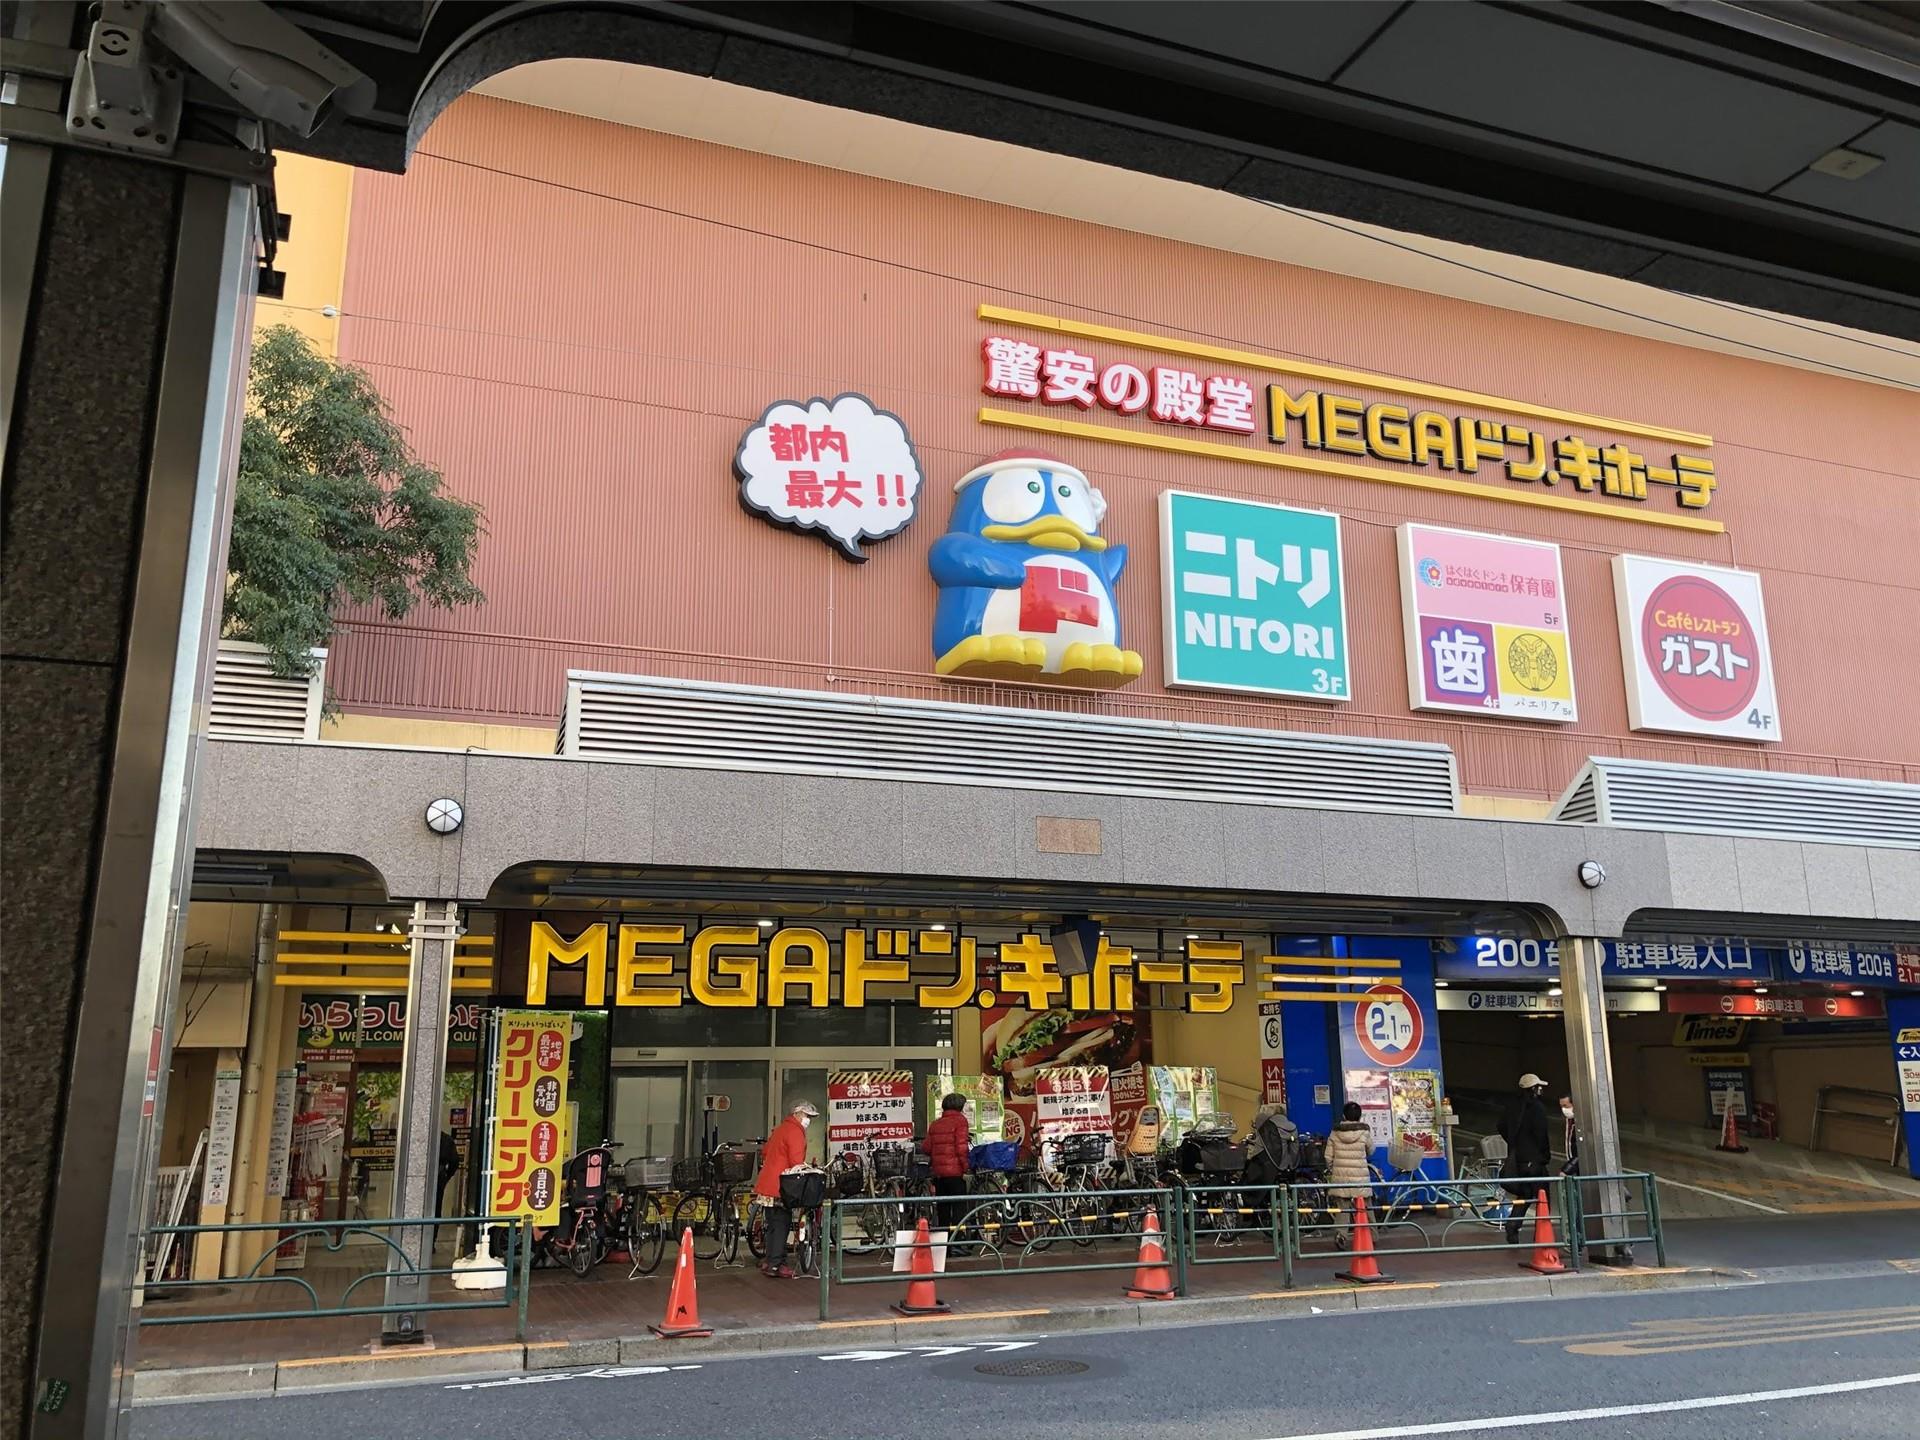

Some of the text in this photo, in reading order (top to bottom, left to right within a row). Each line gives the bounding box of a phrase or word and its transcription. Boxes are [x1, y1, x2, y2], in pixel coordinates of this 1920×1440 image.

[984, 336, 1255, 434] 驚安の殿堂
[769, 424, 850, 463] 都内
[1183, 531, 1331, 608] ニトリ
[1510, 573, 1556, 598] 保育園
[1544, 612, 1559, 625] 5F
[1184, 611, 1336, 661] NITORI
[1430, 629, 1487, 695] 歯
[1661, 635, 1749, 681] ガスト
[1312, 669, 1343, 696] 3F
[1483, 695, 1500, 709] 4F
[1747, 707, 1772, 730] 4F
[1615, 941, 1753, 971] 駐車場入口
[1810, 949, 1853, 976] 駐車場
[1856, 952, 1893, 977] 200台
[1484, 995, 1537, 1008] 駐車場入口
[1545, 996, 1563, 1008] 高さ
[1754, 999, 1804, 1012] 対向車注意
[339, 1030, 477, 1043] WELCOM QUI
[1371, 1006, 1412, 1041] 2.1m
[1683, 1019, 1739, 1041] Times
[538, 1034, 562, 1067] 地域 最安値
[535, 1081, 558, 1111] 非対面 受付
[847, 1084, 893, 1097] お知らせ
[1110, 1076, 1145, 1092] 直火焼き
[836, 1100, 906, 1110] 新規テナント工事が
[496, 1028, 535, 1212] クリーニング
[539, 1123, 550, 1162] 工場直営
[534, 1169, 548, 1209] 当日仕上
